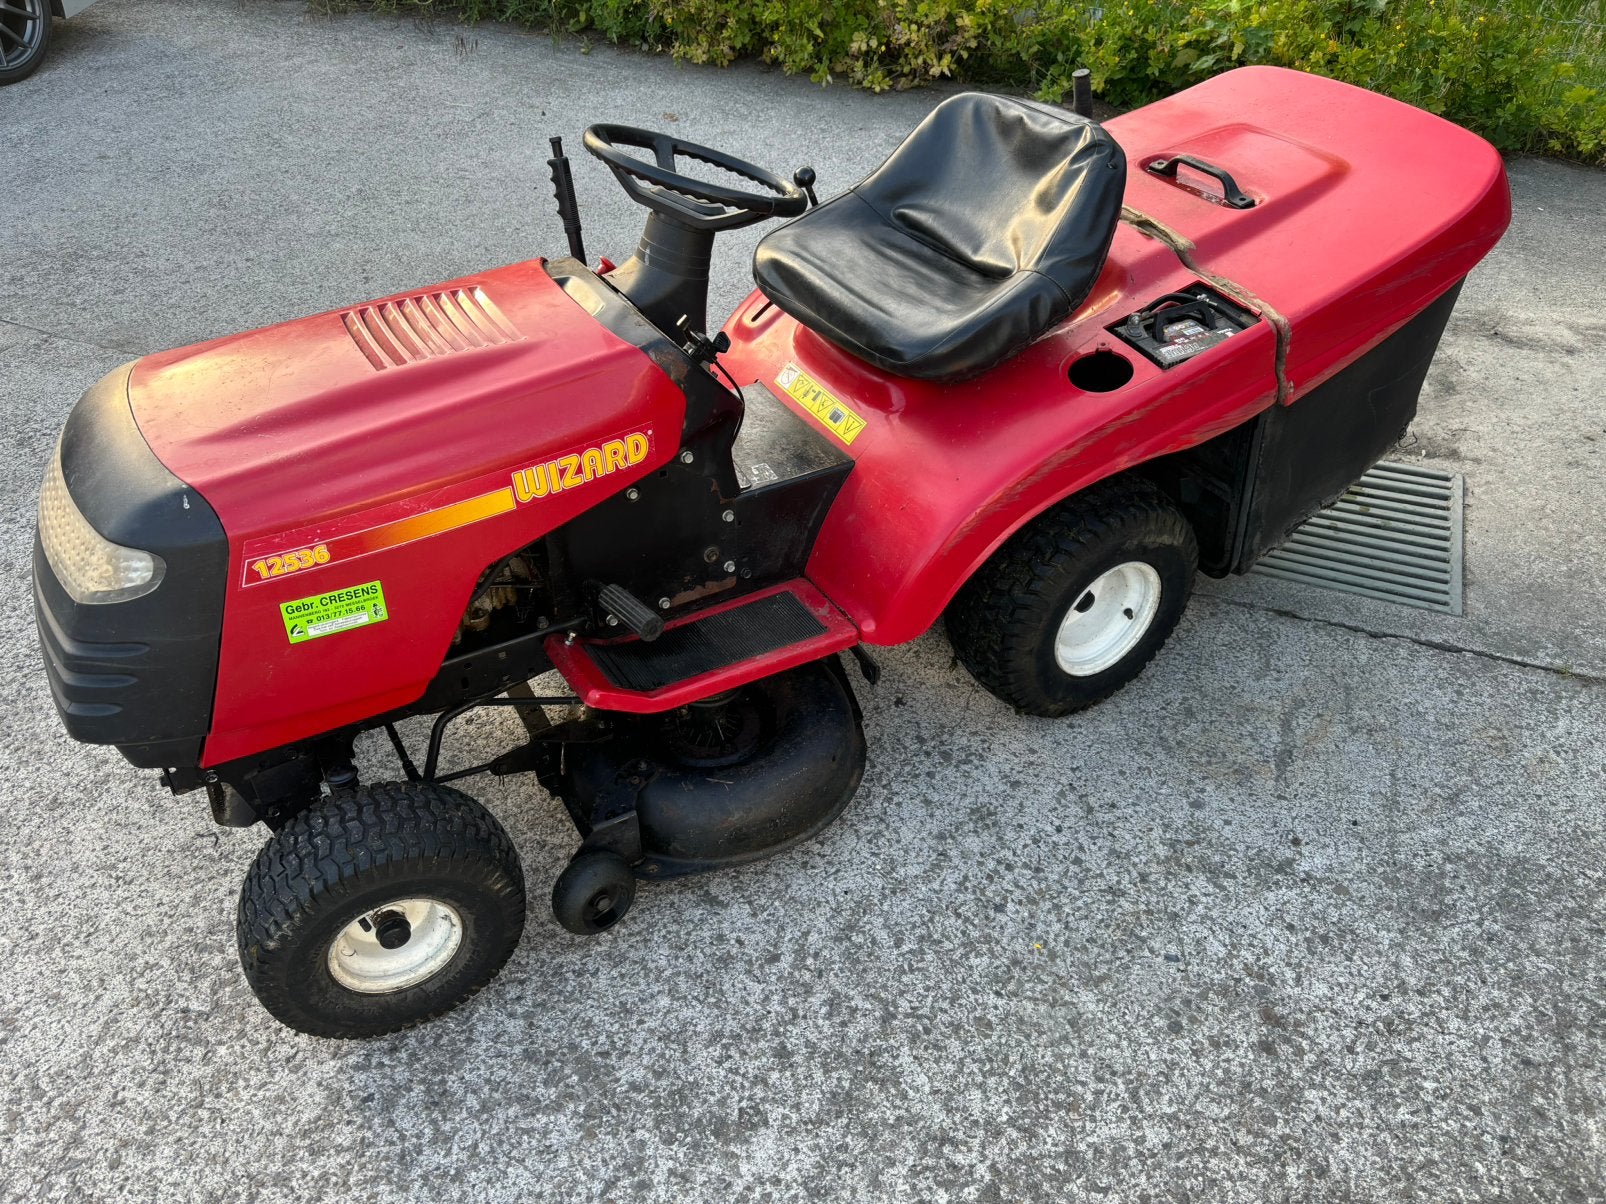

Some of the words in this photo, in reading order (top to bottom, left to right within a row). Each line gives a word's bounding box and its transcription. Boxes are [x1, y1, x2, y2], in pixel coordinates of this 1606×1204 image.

[511, 432, 649, 502] WIZARD
[251, 544, 331, 580] 12536
[285, 602, 319, 615] Gebr.
[319, 584, 378, 607] CRESENS
[316, 604, 366, 622] 013/77.15.66
